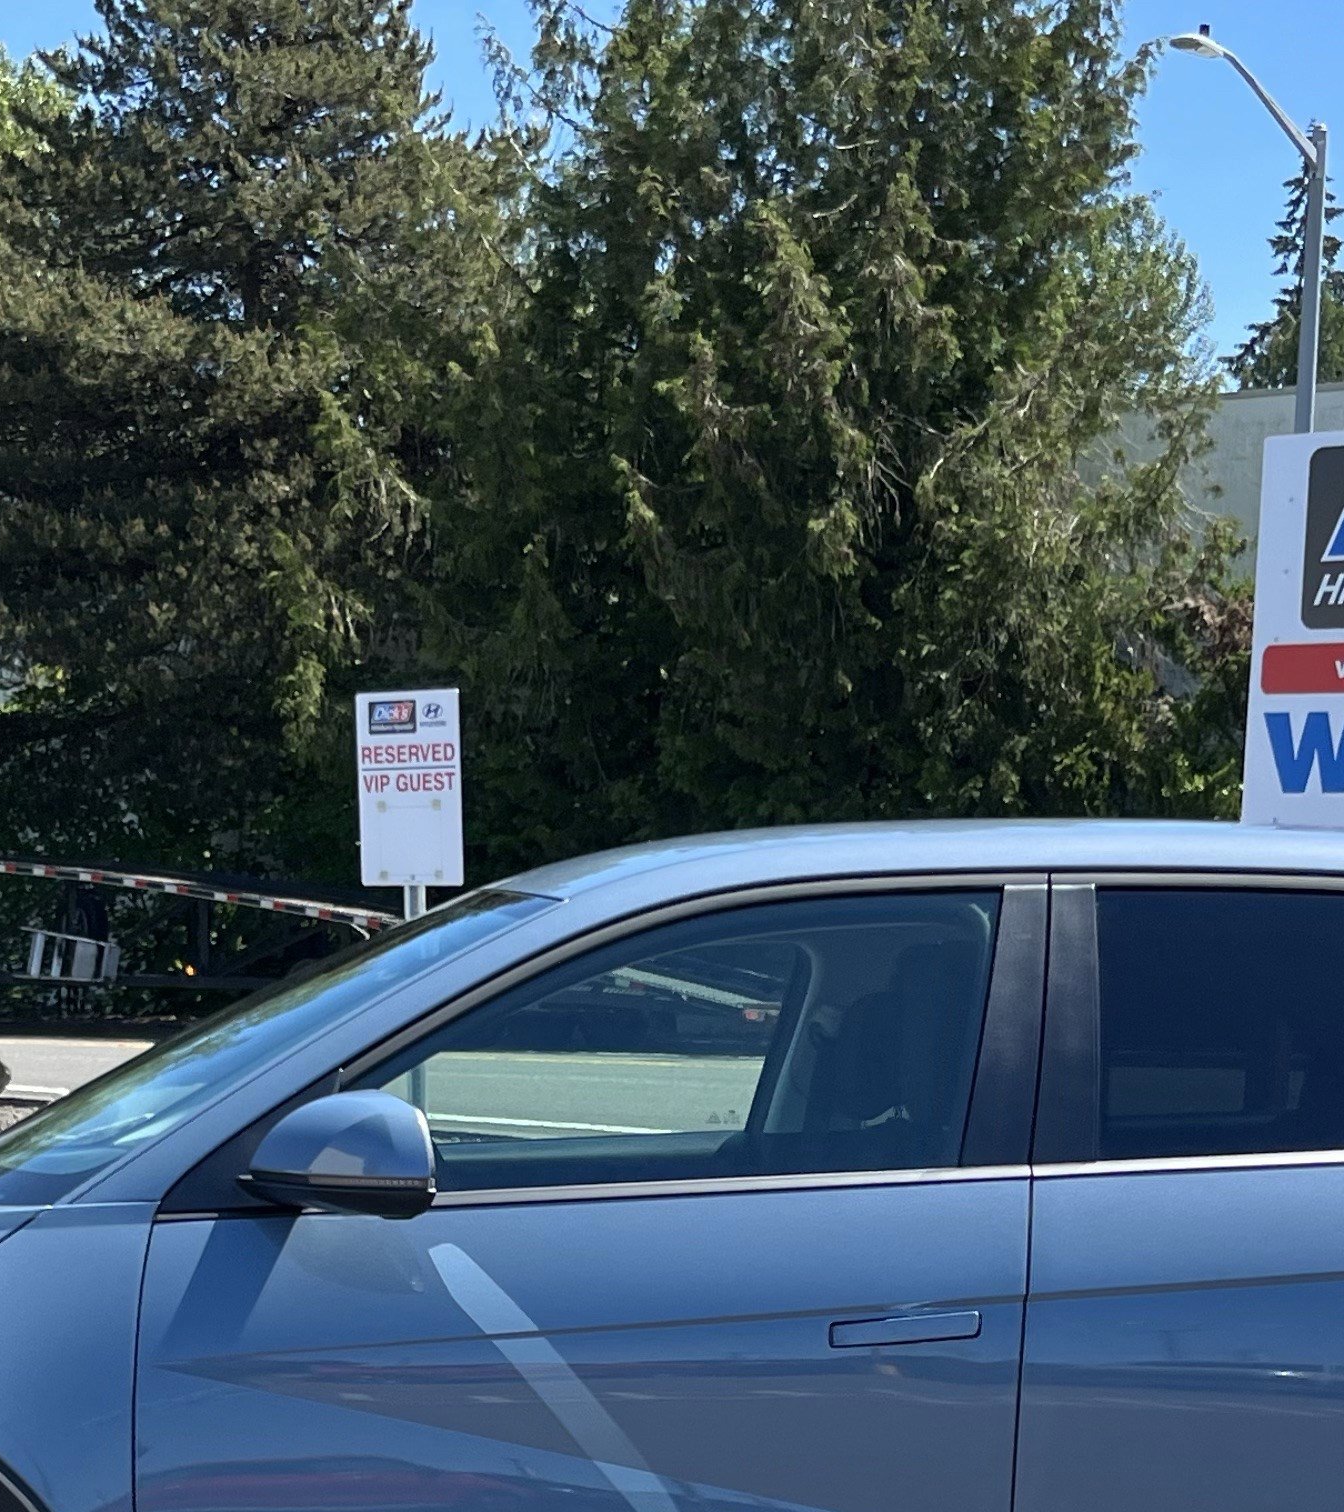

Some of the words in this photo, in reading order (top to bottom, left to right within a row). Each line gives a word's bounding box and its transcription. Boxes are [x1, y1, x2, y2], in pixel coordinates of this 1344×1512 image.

[362, 742, 455, 765] RESERVED
[363, 774, 390, 793] VIP
[396, 771, 455, 792] GUEST
